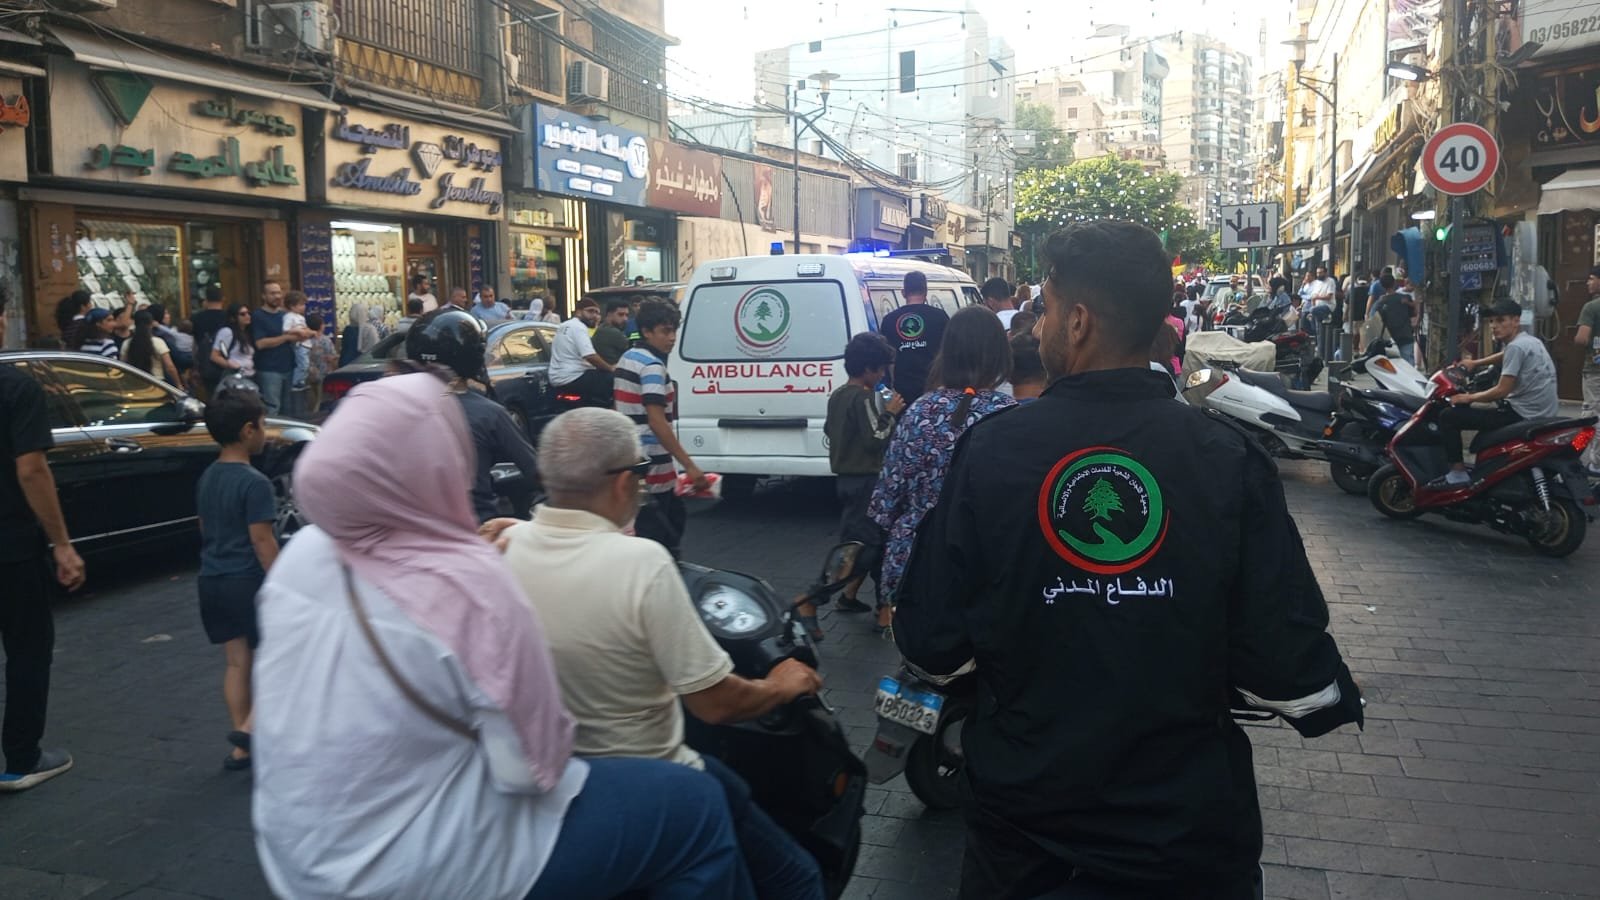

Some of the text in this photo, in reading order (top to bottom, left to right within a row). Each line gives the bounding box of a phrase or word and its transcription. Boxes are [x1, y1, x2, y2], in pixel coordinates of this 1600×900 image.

[1530, 16, 1600, 44] 03/95822
[543, 121, 597, 152] التوفير
[86, 144, 155, 176] بدر
[246, 146, 299, 186] علي
[1440, 145, 1479, 173] 40
[685, 163, 719, 202] مجوهرات
[691, 363, 833, 379] AMBULANCE
[691, 379, 833, 397] إسعاف
[1042, 575, 1174, 605] الدفاع المدني
